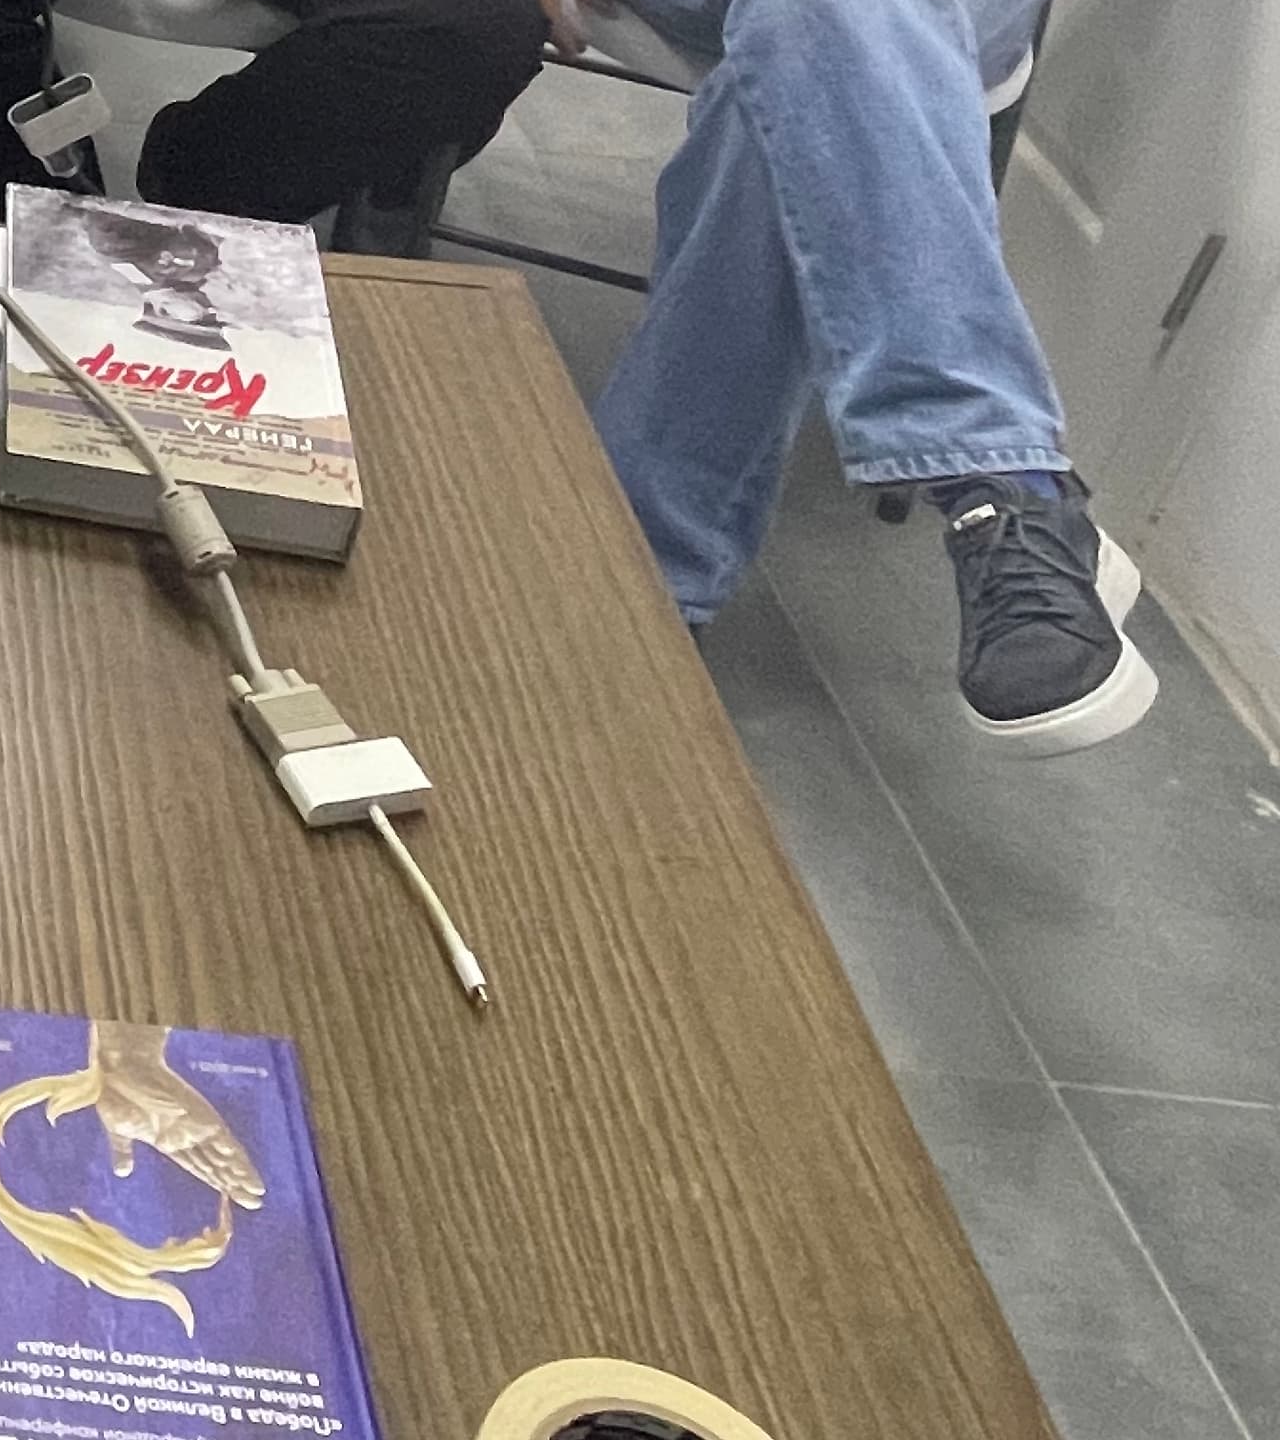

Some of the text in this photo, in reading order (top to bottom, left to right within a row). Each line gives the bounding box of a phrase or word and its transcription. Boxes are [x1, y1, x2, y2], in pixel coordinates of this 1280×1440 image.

[183, 418, 312, 452] ГЕНЕРАЛ
[17, 1340, 320, 1387] в жизни еврейского народа»
[69, 1366, 215, 1396] историческое
[220, 1385, 256, 1400] как
[134, 1396, 226, 1424] Великой
[259, 1388, 324, 1409] войне
[230, 1407, 242, 1421] в
[246, 1407, 342, 1436] «Победа
